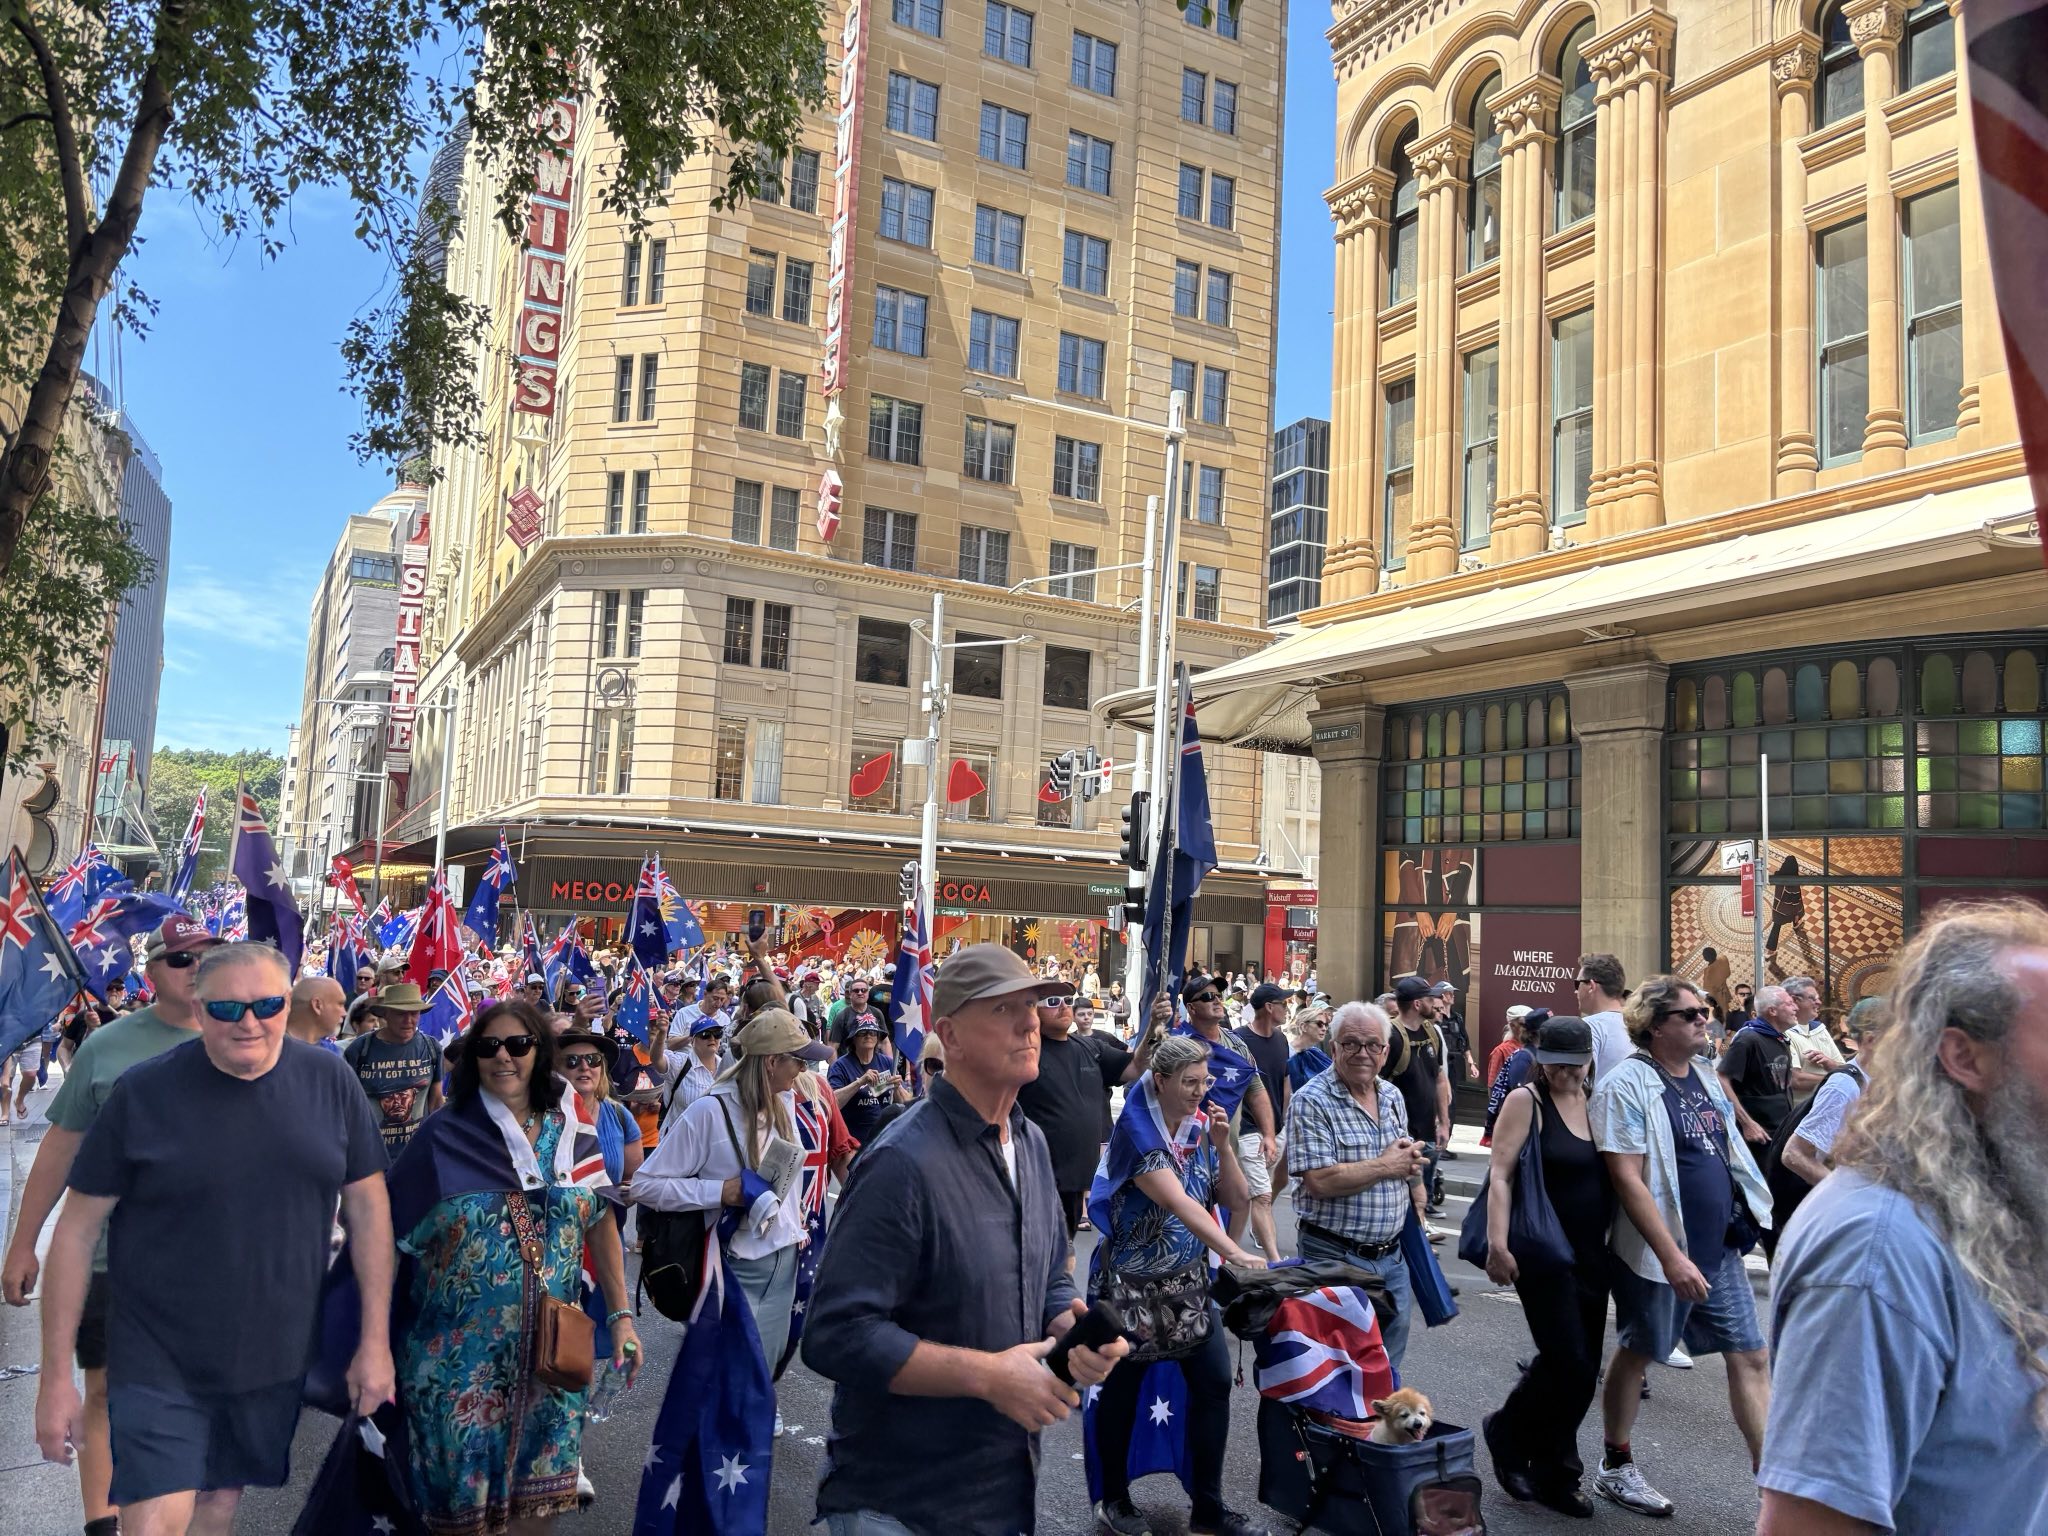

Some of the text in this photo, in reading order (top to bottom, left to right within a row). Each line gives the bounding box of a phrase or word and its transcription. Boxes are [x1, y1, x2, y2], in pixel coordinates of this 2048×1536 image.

[825, 3, 859, 397] GOWINGS
[514, 102, 574, 408] OWINGS
[389, 567, 426, 750] STATE
[1315, 729, 1349, 740] MARKET ST
[551, 881, 639, 902] MECCA
[934, 882, 992, 903] ECCA
[1091, 886, 1113, 895] George
[1268, 892, 1292, 902] Kidstuff
[941, 909, 959, 917] George
[1293, 929, 1315, 938] Kidstuff
[1513, 950, 1554, 964] WHERE
[1494, 963, 1575, 979] IMAGINATION
[1511, 979, 1556, 994] REIGNS
[360, 1070, 377, 1079] BUT
[385, 1070, 404, 1078] GOT
[406, 1069, 417, 1077] TO
[419, 1065, 432, 1075] SEE
[377, 1061, 396, 1070] MAY
[397, 1060, 407, 1068] BE
[1680, 1110, 1726, 1134] MTS
